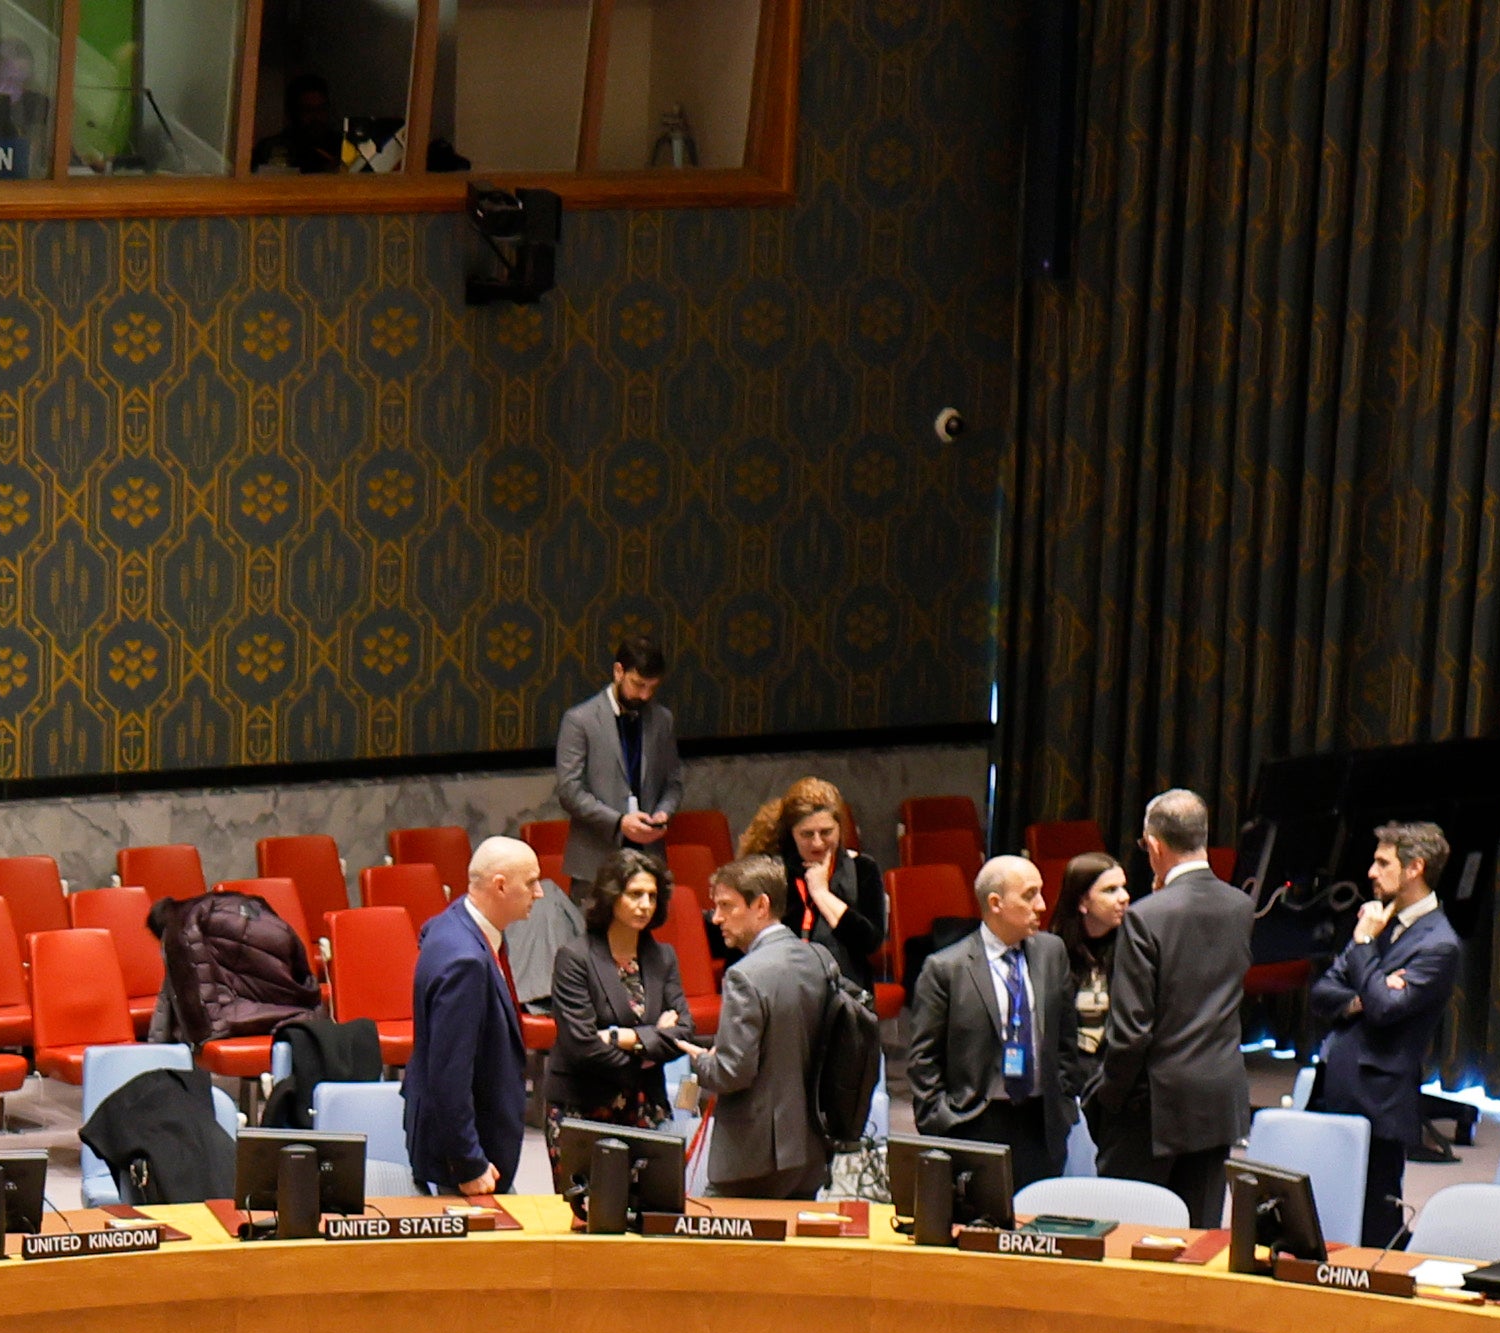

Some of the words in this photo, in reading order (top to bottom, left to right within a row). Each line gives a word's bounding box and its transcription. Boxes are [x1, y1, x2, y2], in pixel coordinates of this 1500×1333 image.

[329, 1219, 391, 1237] UNITED
[399, 1217, 464, 1235] STATES
[675, 1216, 753, 1237] ALBANIA
[27, 1235, 82, 1254] UNITED
[88, 1229, 157, 1249] KINGDOM
[998, 1233, 1062, 1255] BRAZIL
[1316, 1263, 1370, 1289] CHINA
